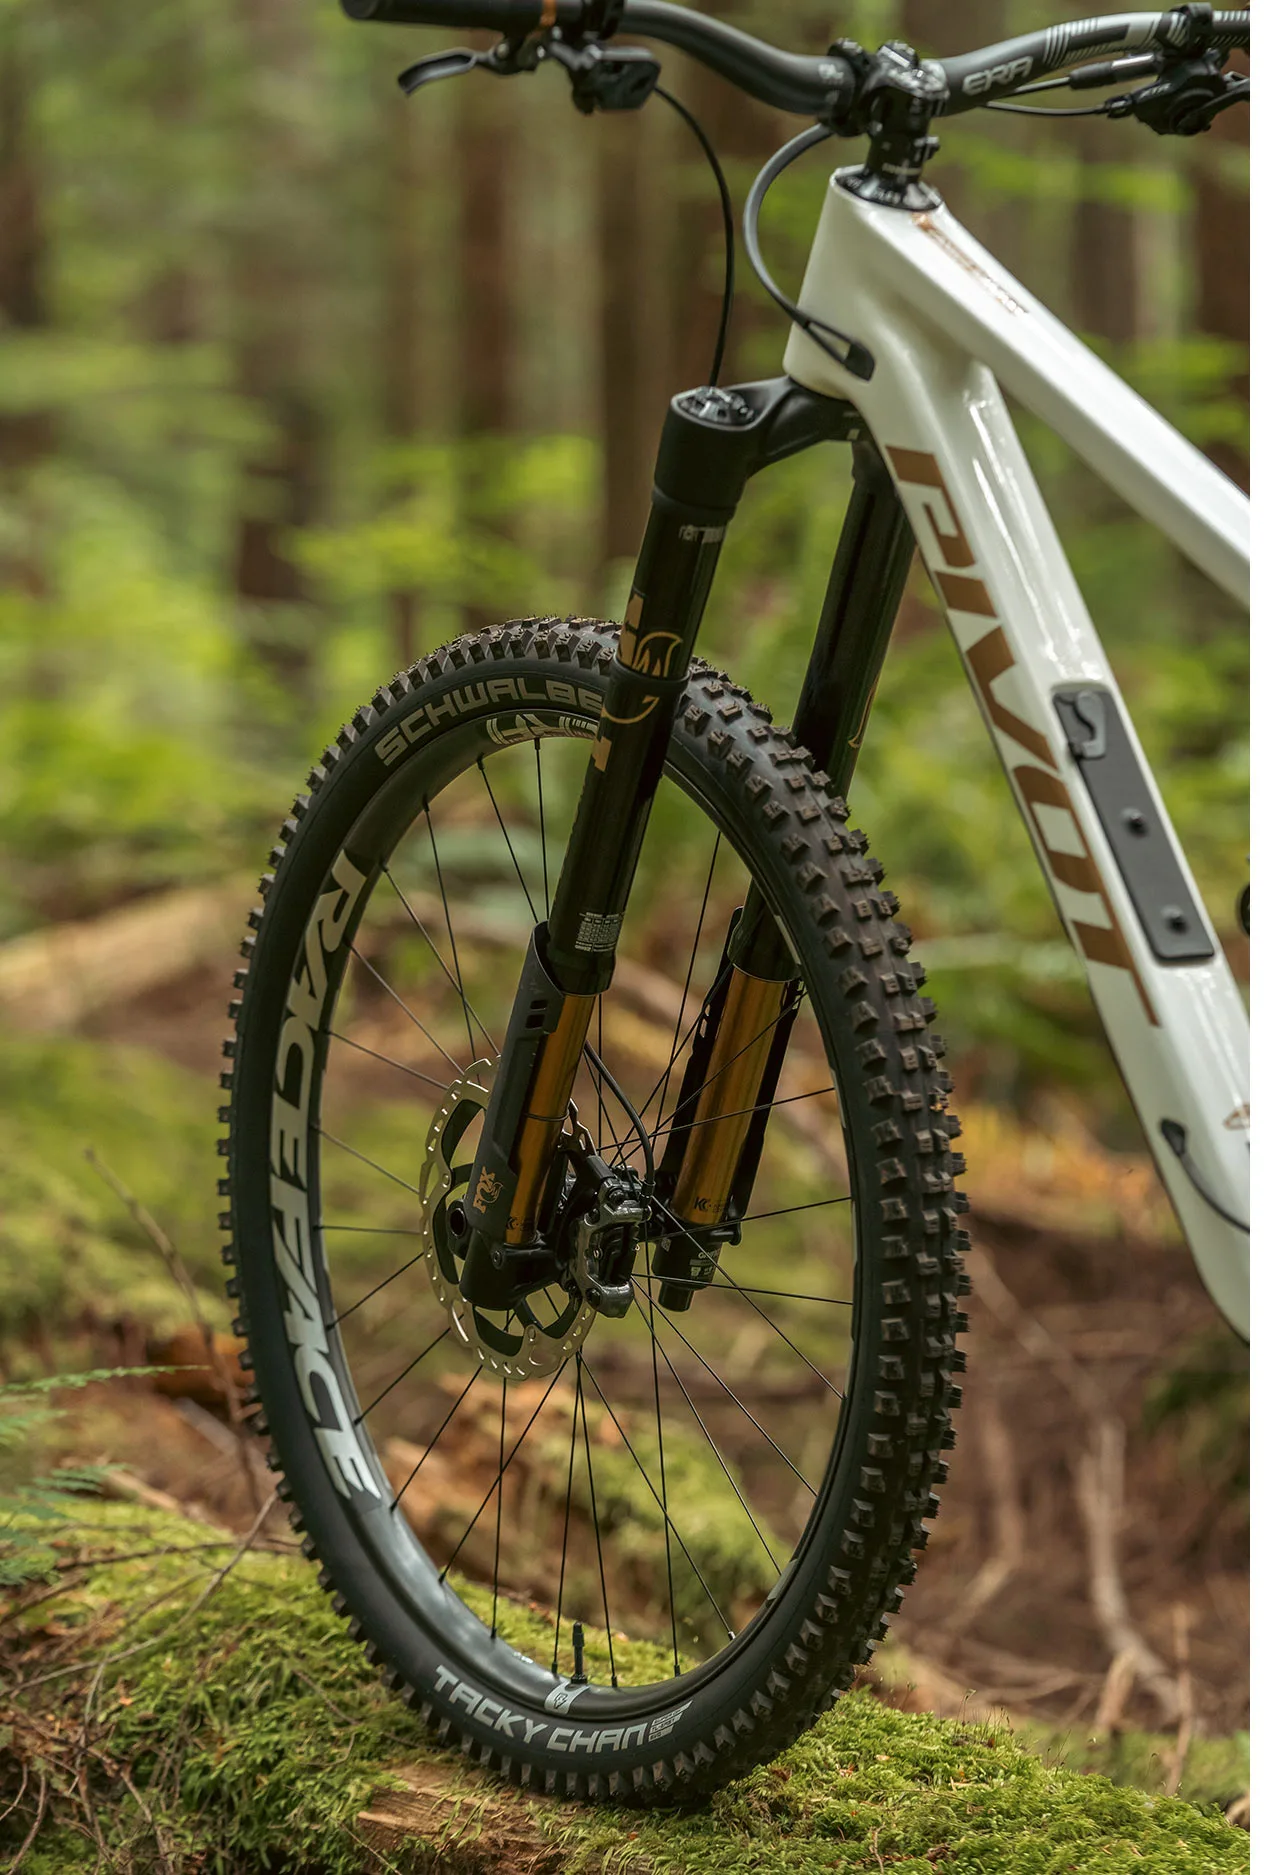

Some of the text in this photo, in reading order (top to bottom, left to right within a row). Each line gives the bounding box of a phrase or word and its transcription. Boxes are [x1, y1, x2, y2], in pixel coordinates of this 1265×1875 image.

[962, 56, 1034, 96] ERA
[374, 677, 603, 767] SCHWALBE
[886, 445, 1162, 1028] PIVOT
[472, 1165, 504, 1214] FOX
[433, 1664, 649, 1753] TACKY CHAN
